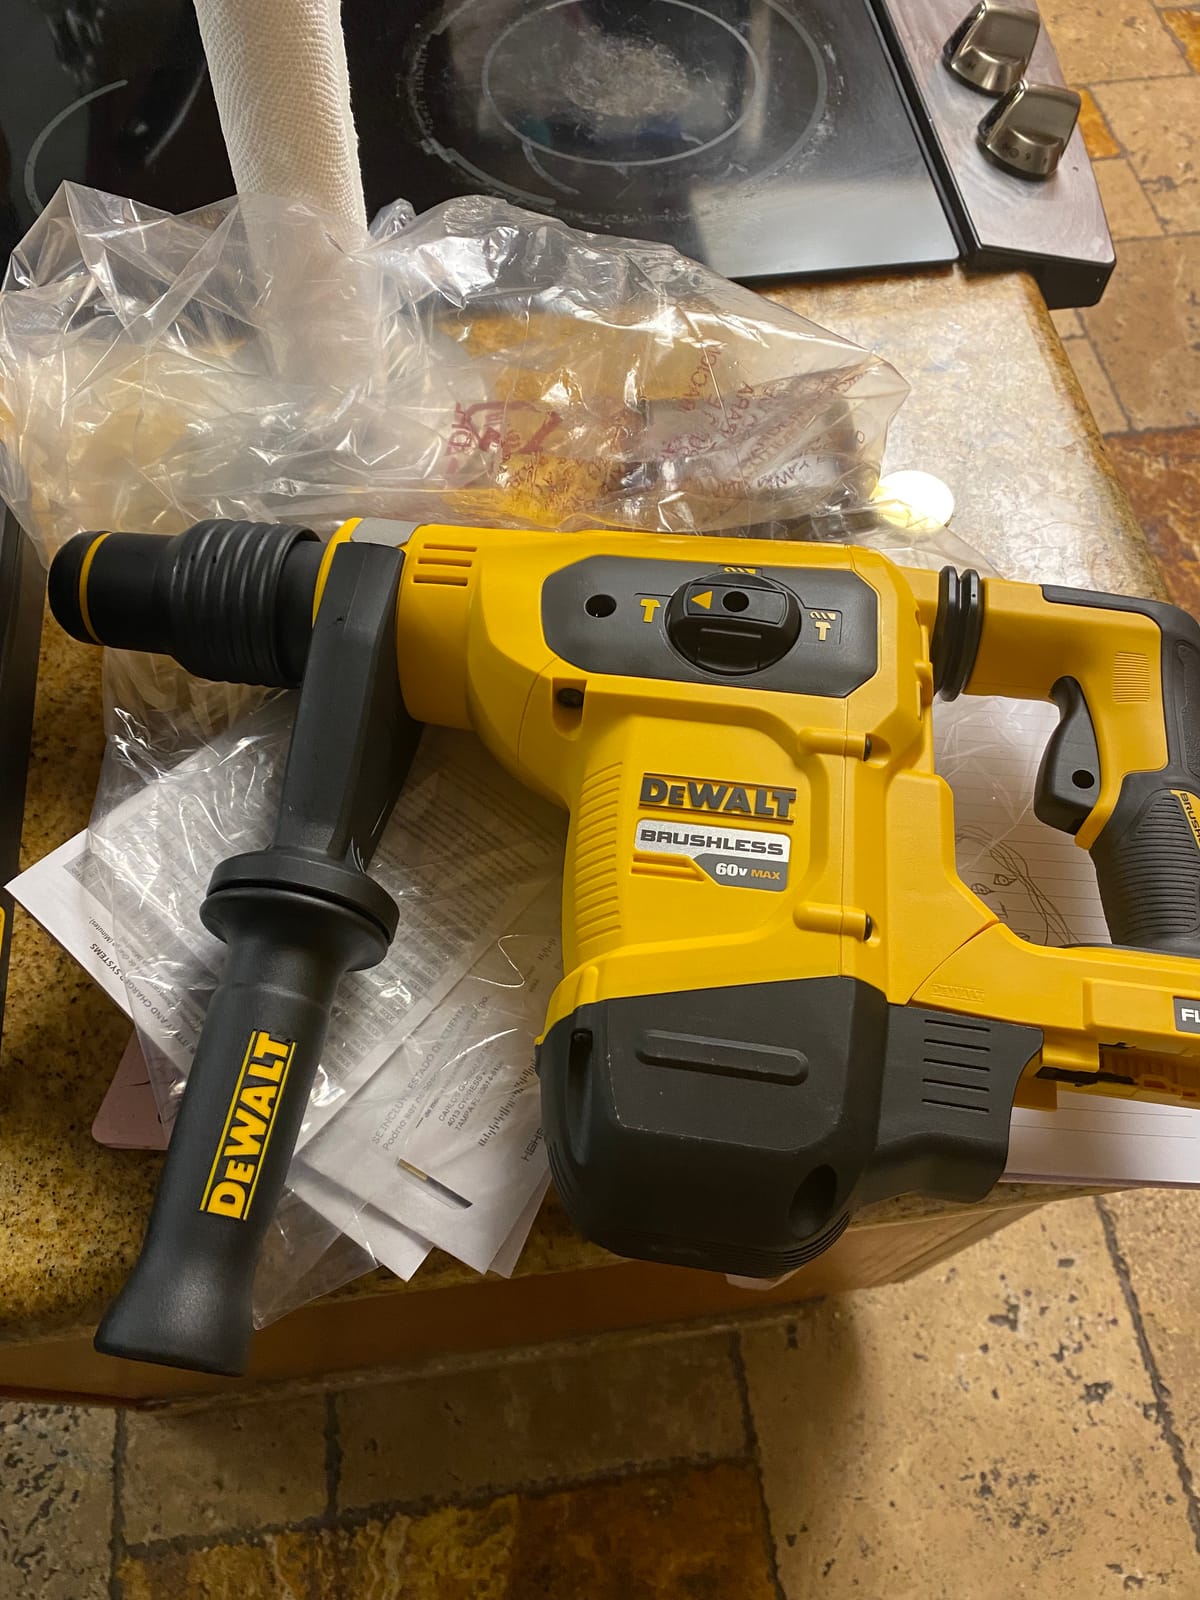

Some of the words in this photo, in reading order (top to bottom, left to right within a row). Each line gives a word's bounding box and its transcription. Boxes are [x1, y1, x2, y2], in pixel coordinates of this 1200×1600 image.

[639, 776, 797, 818] DEWALT
[1180, 793, 1200, 843] BRUSH
[640, 828, 784, 856] BRUSHLESS
[751, 868, 781, 881] MAX
[90, 943, 121, 976] SYSTEMS
[206, 1030, 290, 1220] DEWALT
